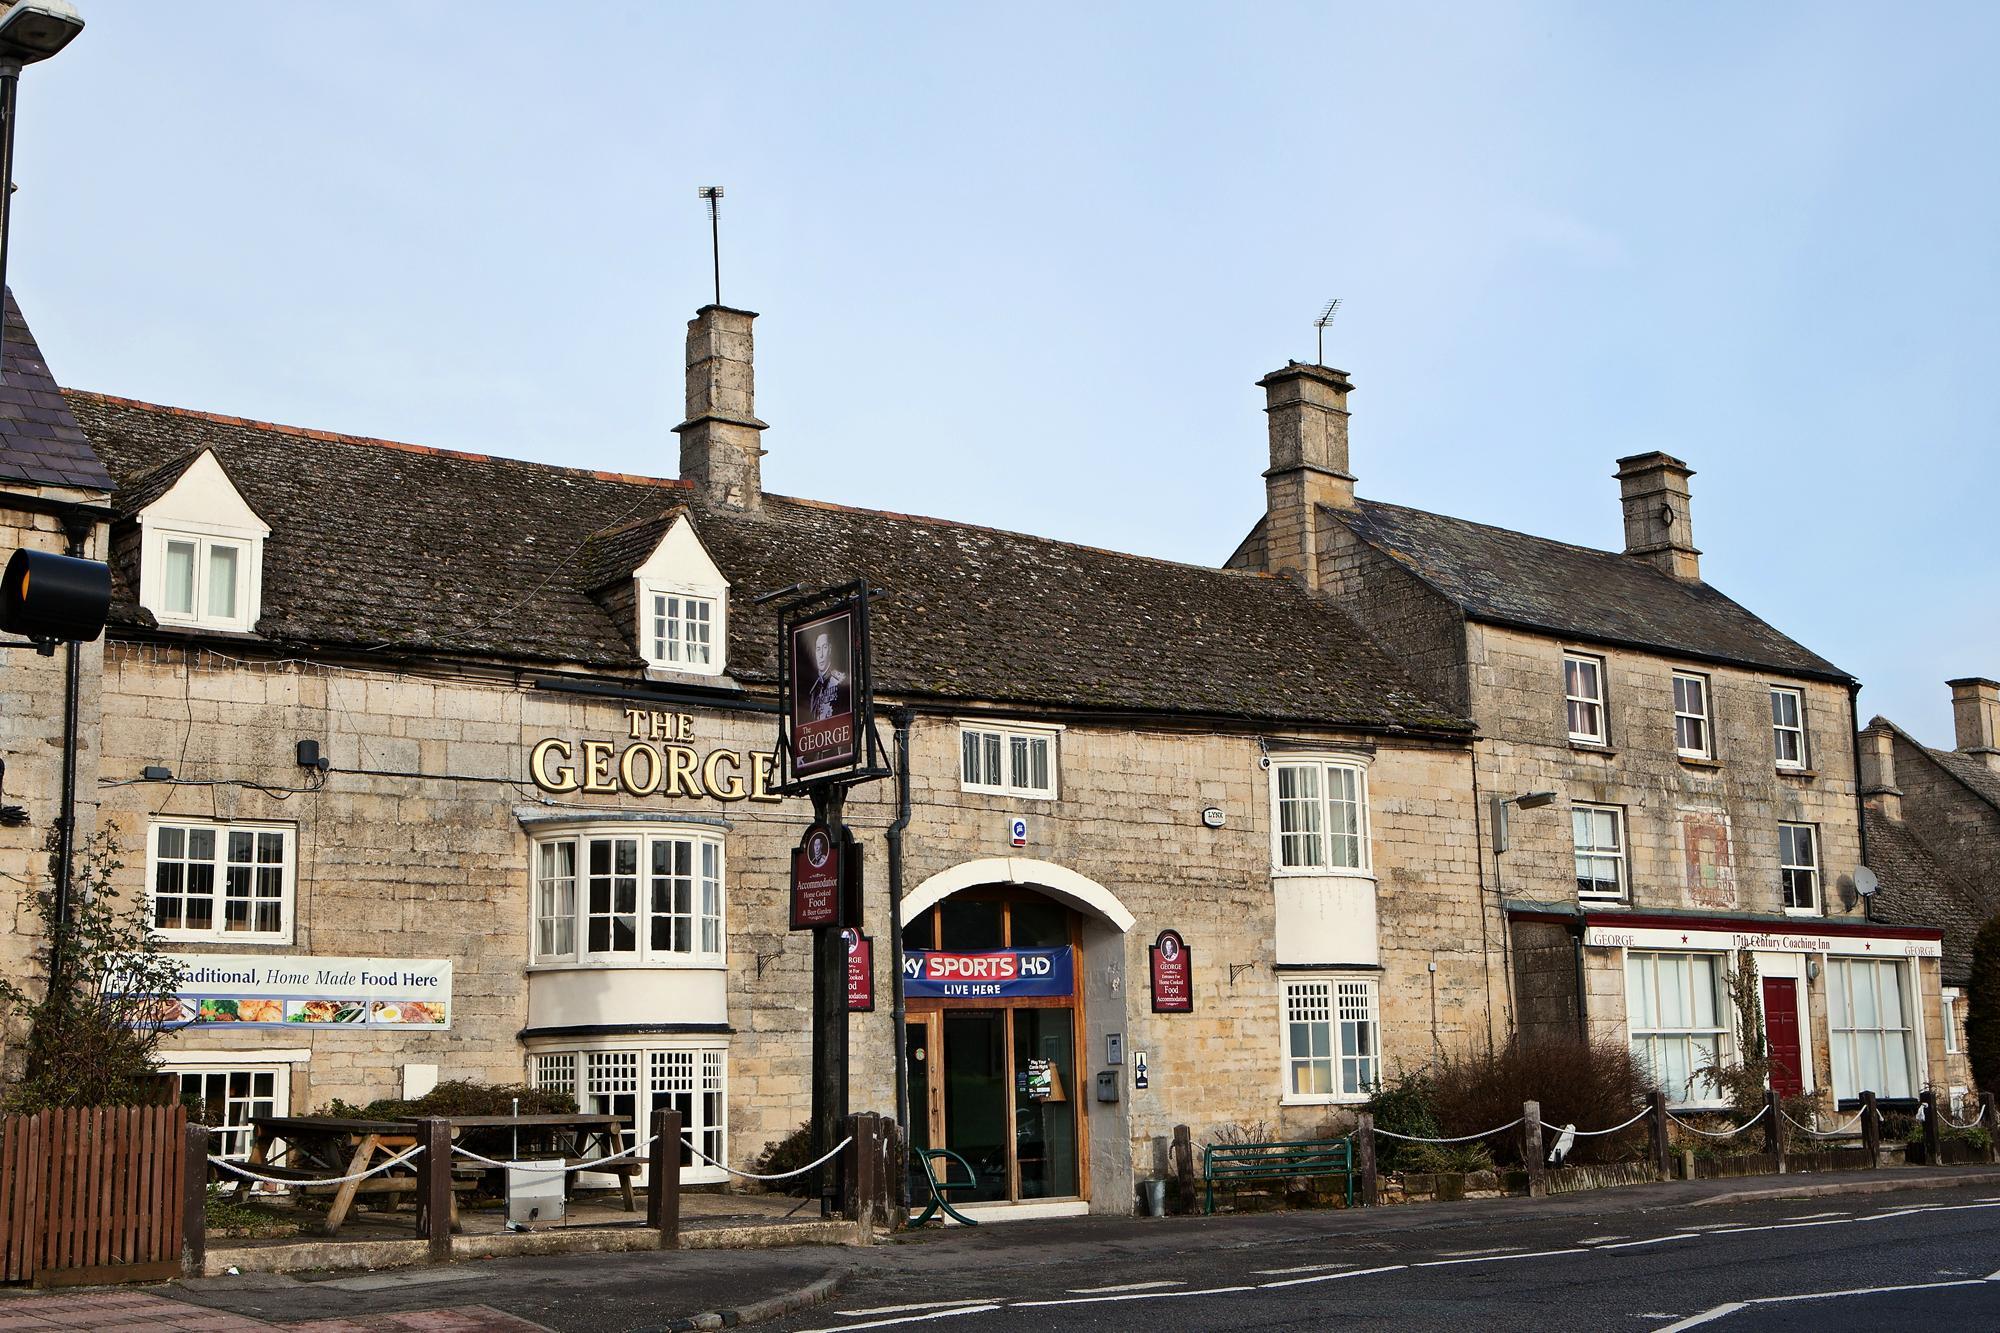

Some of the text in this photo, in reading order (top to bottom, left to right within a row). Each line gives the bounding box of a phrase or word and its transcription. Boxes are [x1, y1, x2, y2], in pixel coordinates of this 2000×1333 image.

[624, 709, 695, 743] THE
[802, 727, 812, 735] The
[798, 725, 851, 752] GEORGE
[530, 738, 783, 803] GEORGE
[815, 889, 832, 897] Cooked
[809, 897, 826, 907] Food
[1594, 934, 1635, 946] GEORGE
[1732, 934, 1831, 951] 17th Century Coaching Inn
[1904, 946, 1936, 956] GEORGE
[902, 953, 1051, 978] ky SPORTS HD
[176, 968, 438, 987] raditional, Home Made Food Here
[848, 981, 857, 990] od
[944, 984, 1001, 995] LIVE HERE
[1164, 985, 1179, 994] Food
